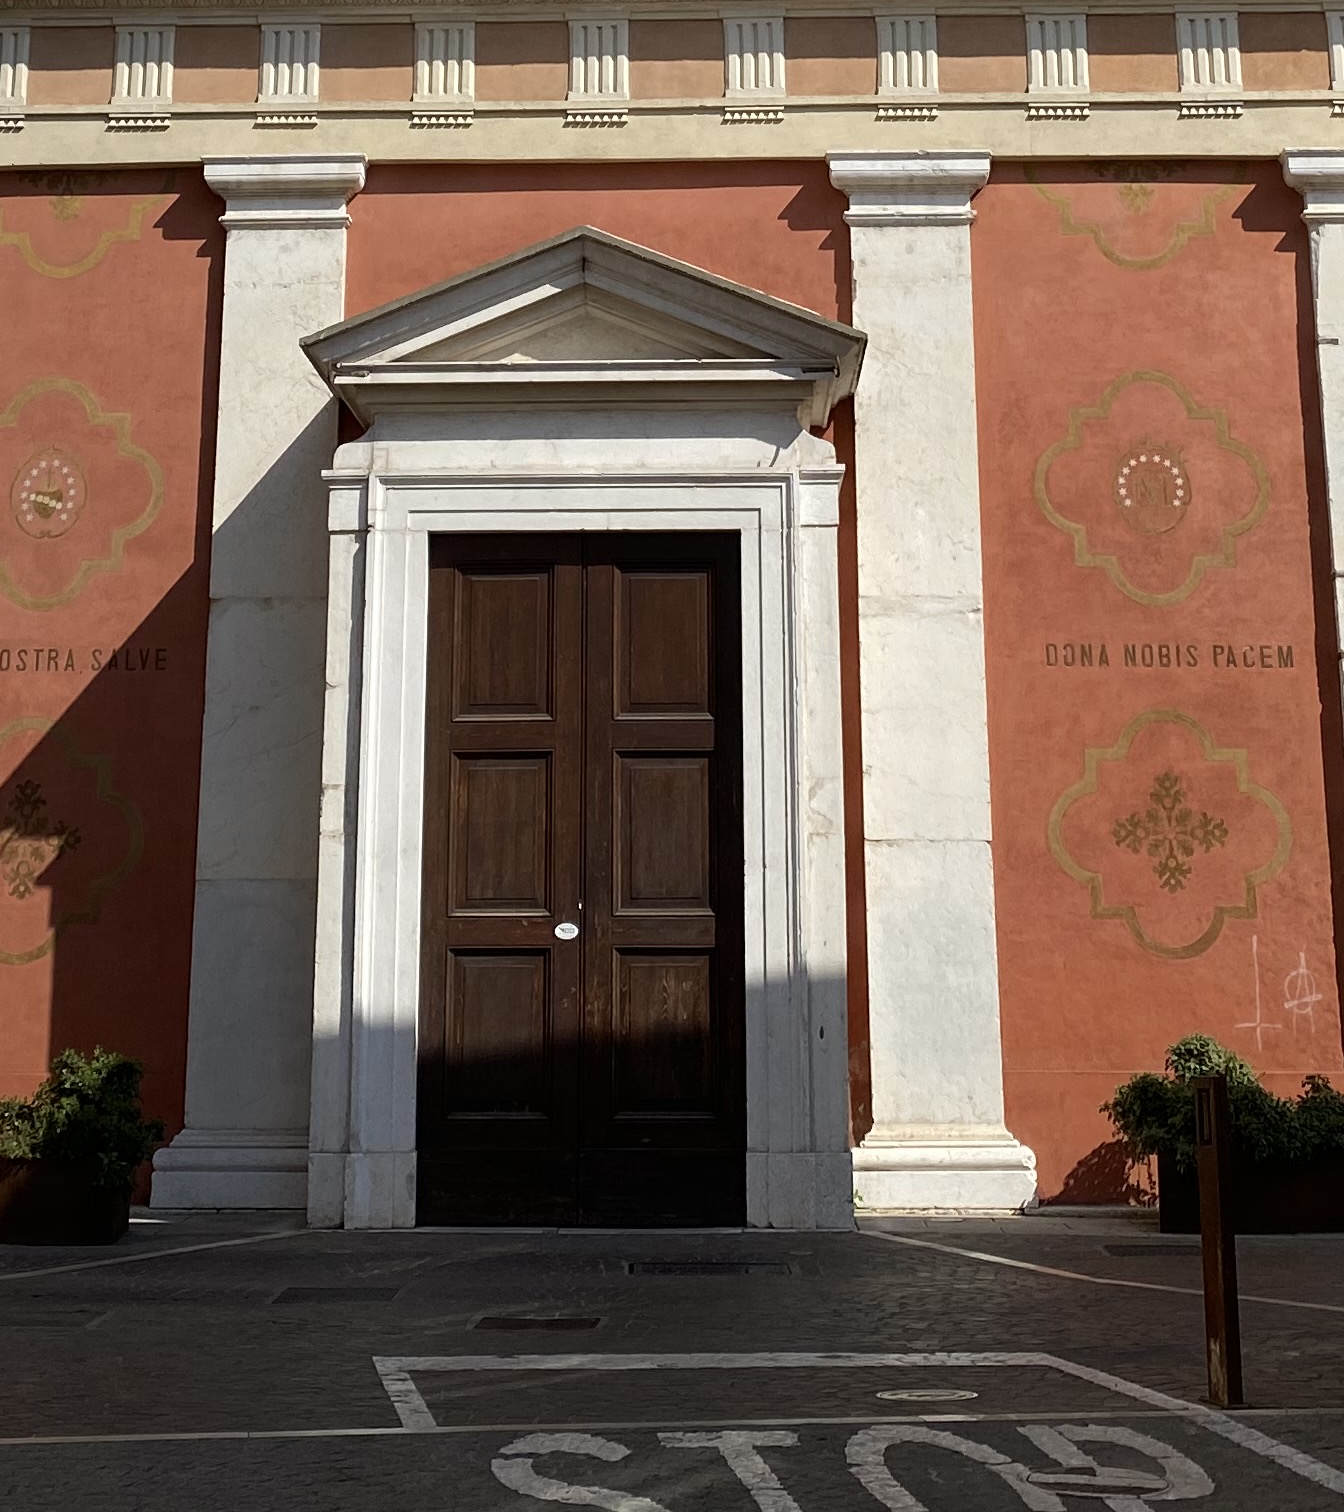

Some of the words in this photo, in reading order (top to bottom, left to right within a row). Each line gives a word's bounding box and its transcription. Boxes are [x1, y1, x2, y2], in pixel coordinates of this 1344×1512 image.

[90, 648, 168, 672] SALVE
[1045, 642, 1110, 668] DONA
[1123, 643, 1199, 668] NOBIS
[1211, 644, 1295, 669] PACEM
